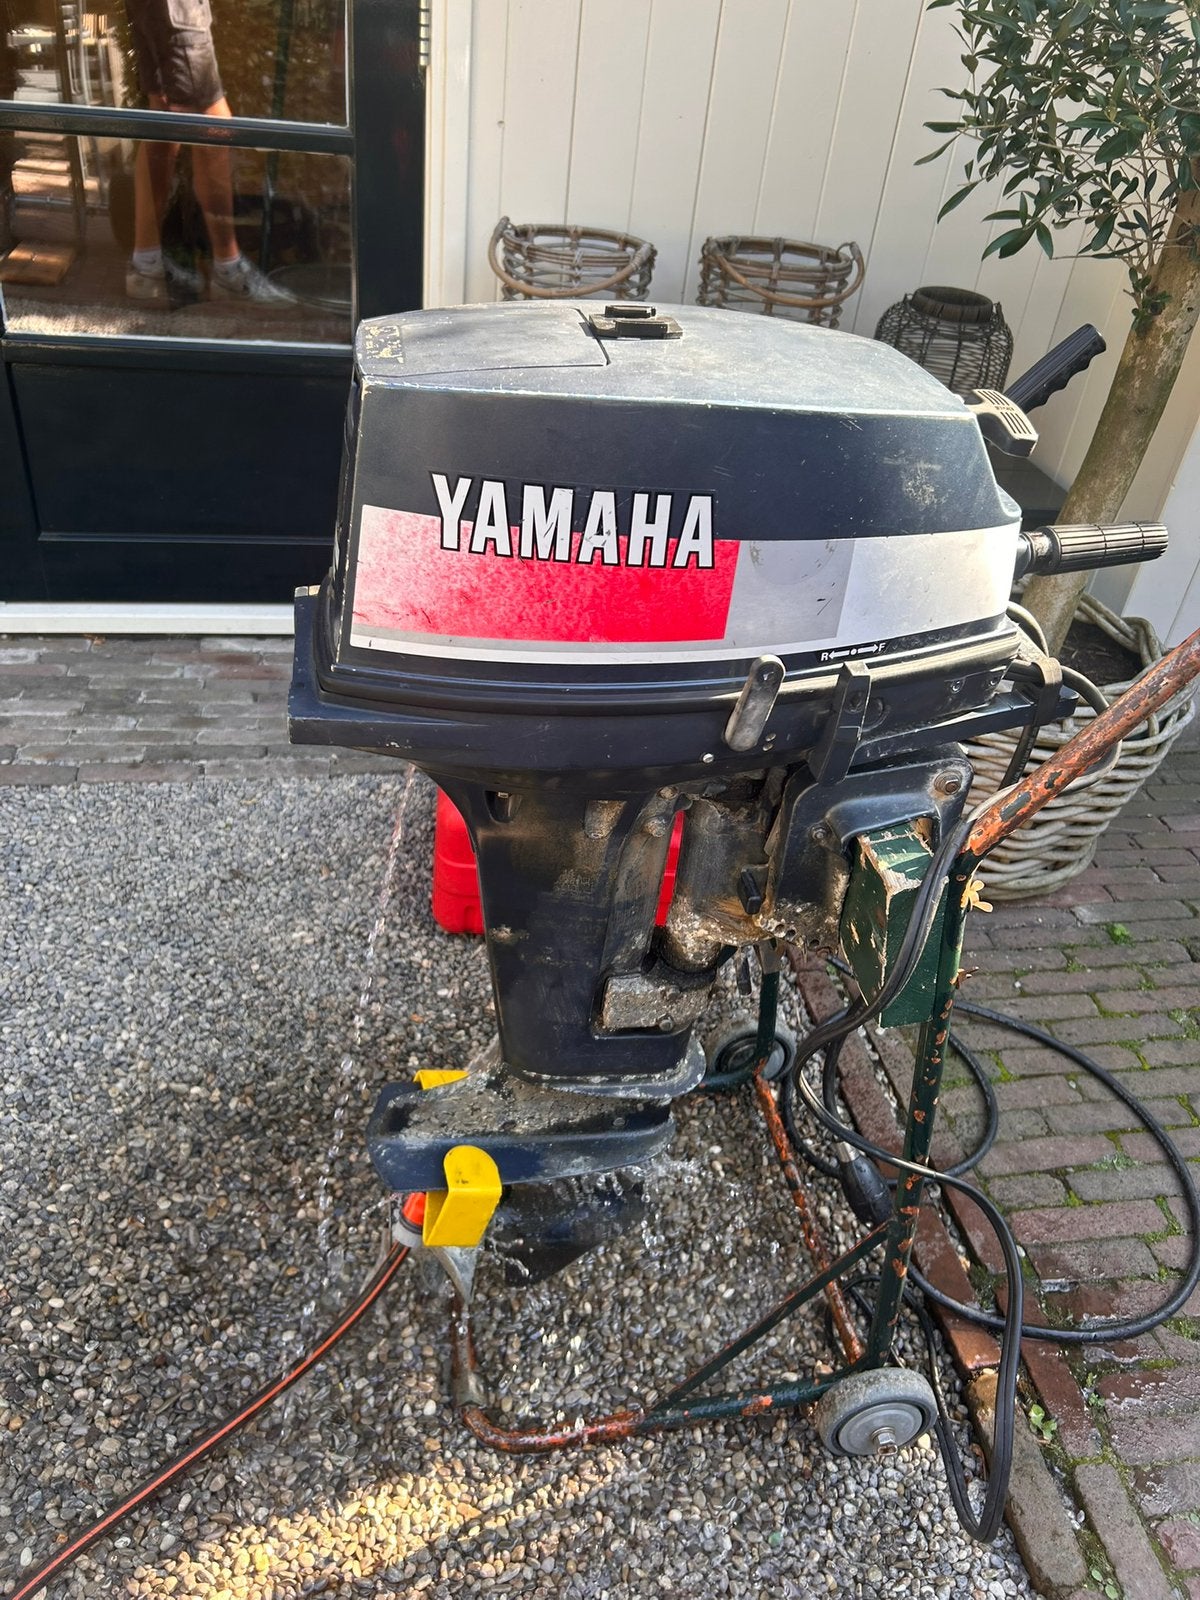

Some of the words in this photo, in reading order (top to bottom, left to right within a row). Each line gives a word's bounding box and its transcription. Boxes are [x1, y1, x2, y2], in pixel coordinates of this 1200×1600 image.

[430, 471, 714, 569] YAMAHA
[820, 652, 829, 661] R
[878, 643, 886, 652] F
